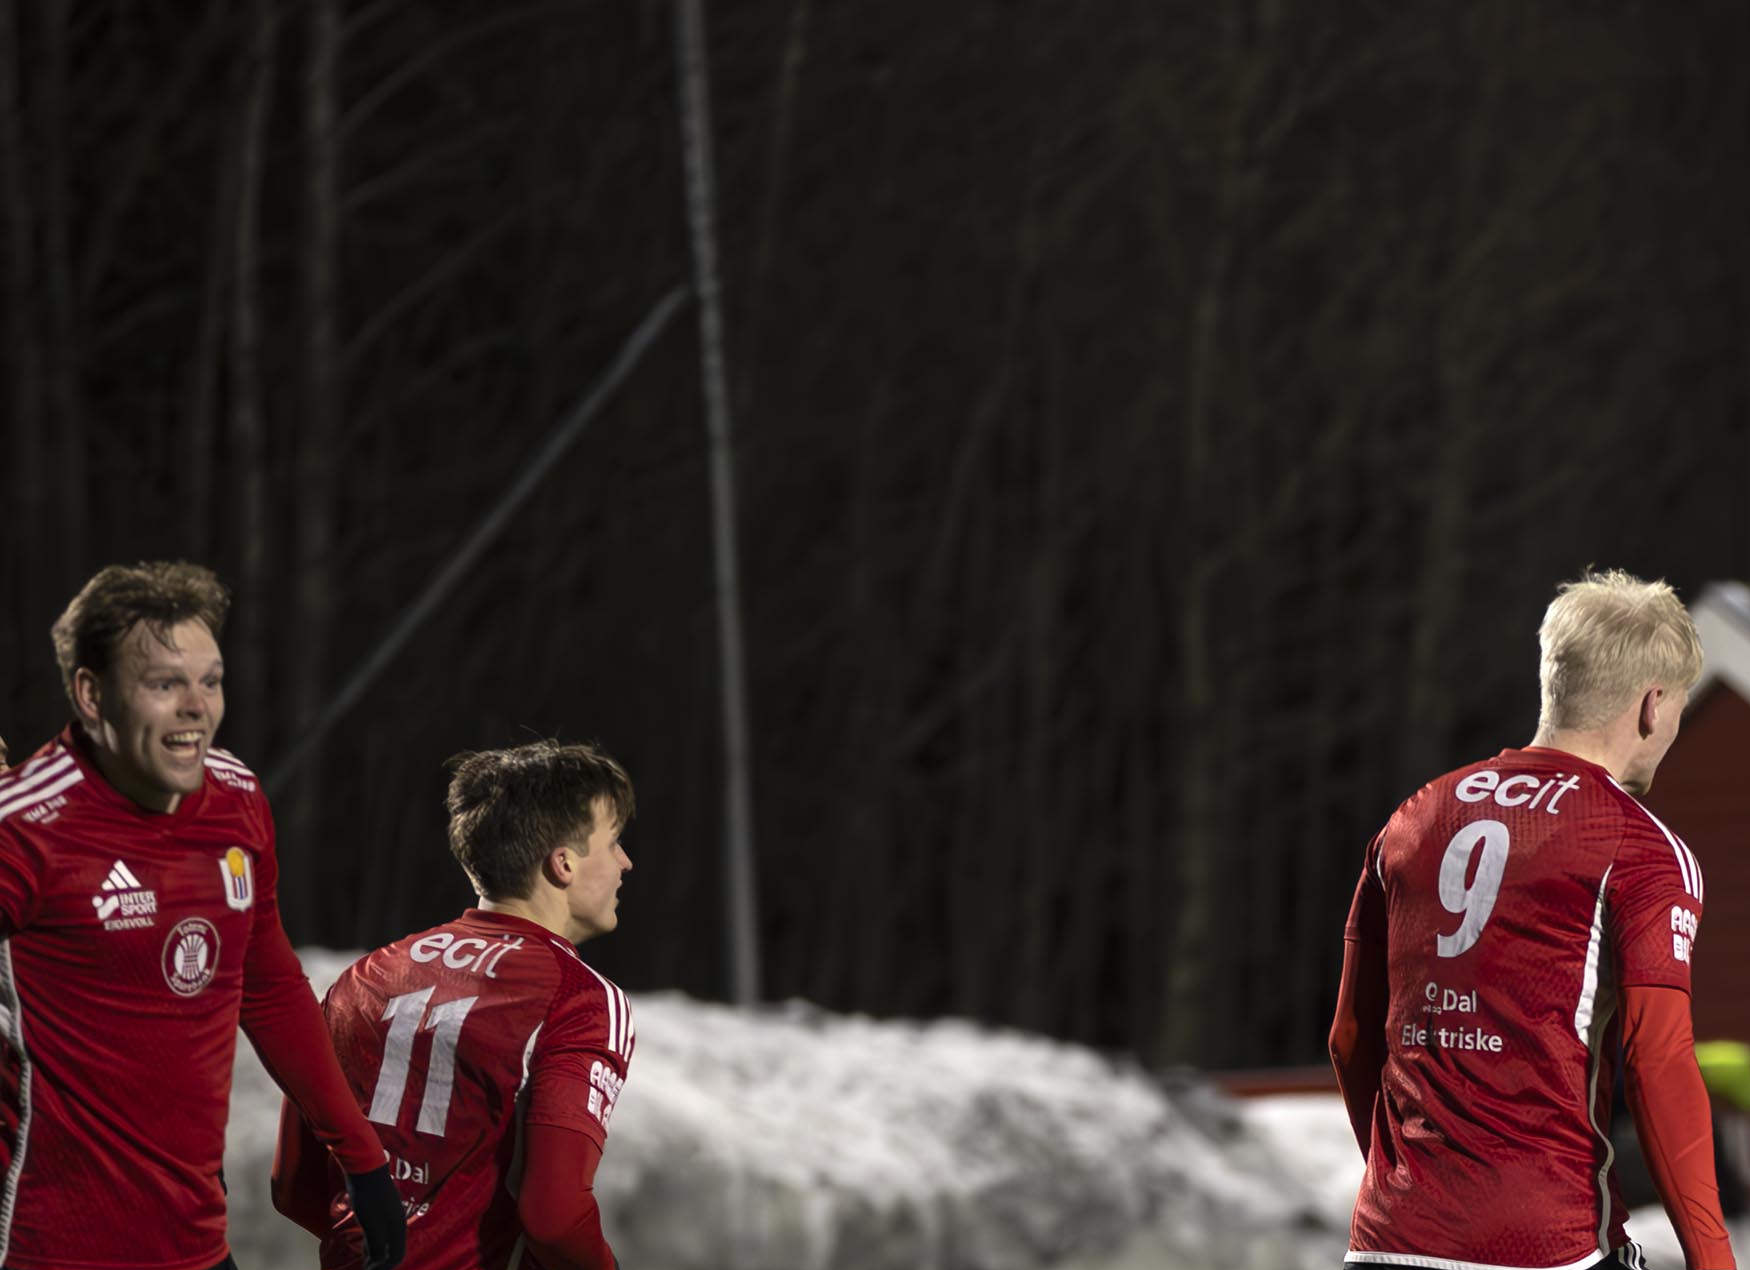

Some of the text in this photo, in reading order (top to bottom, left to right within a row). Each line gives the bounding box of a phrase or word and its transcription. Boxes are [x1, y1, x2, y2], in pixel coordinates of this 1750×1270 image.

[1455, 769, 1581, 815] ecit
[1437, 819, 1510, 958] 9
[410, 932, 525, 979] ecit
[1442, 988, 1478, 1013] Dal
[1401, 1023, 1504, 1053] Eletriske
[367, 985, 480, 1138] 11
[395, 1157, 430, 1185] Dal
